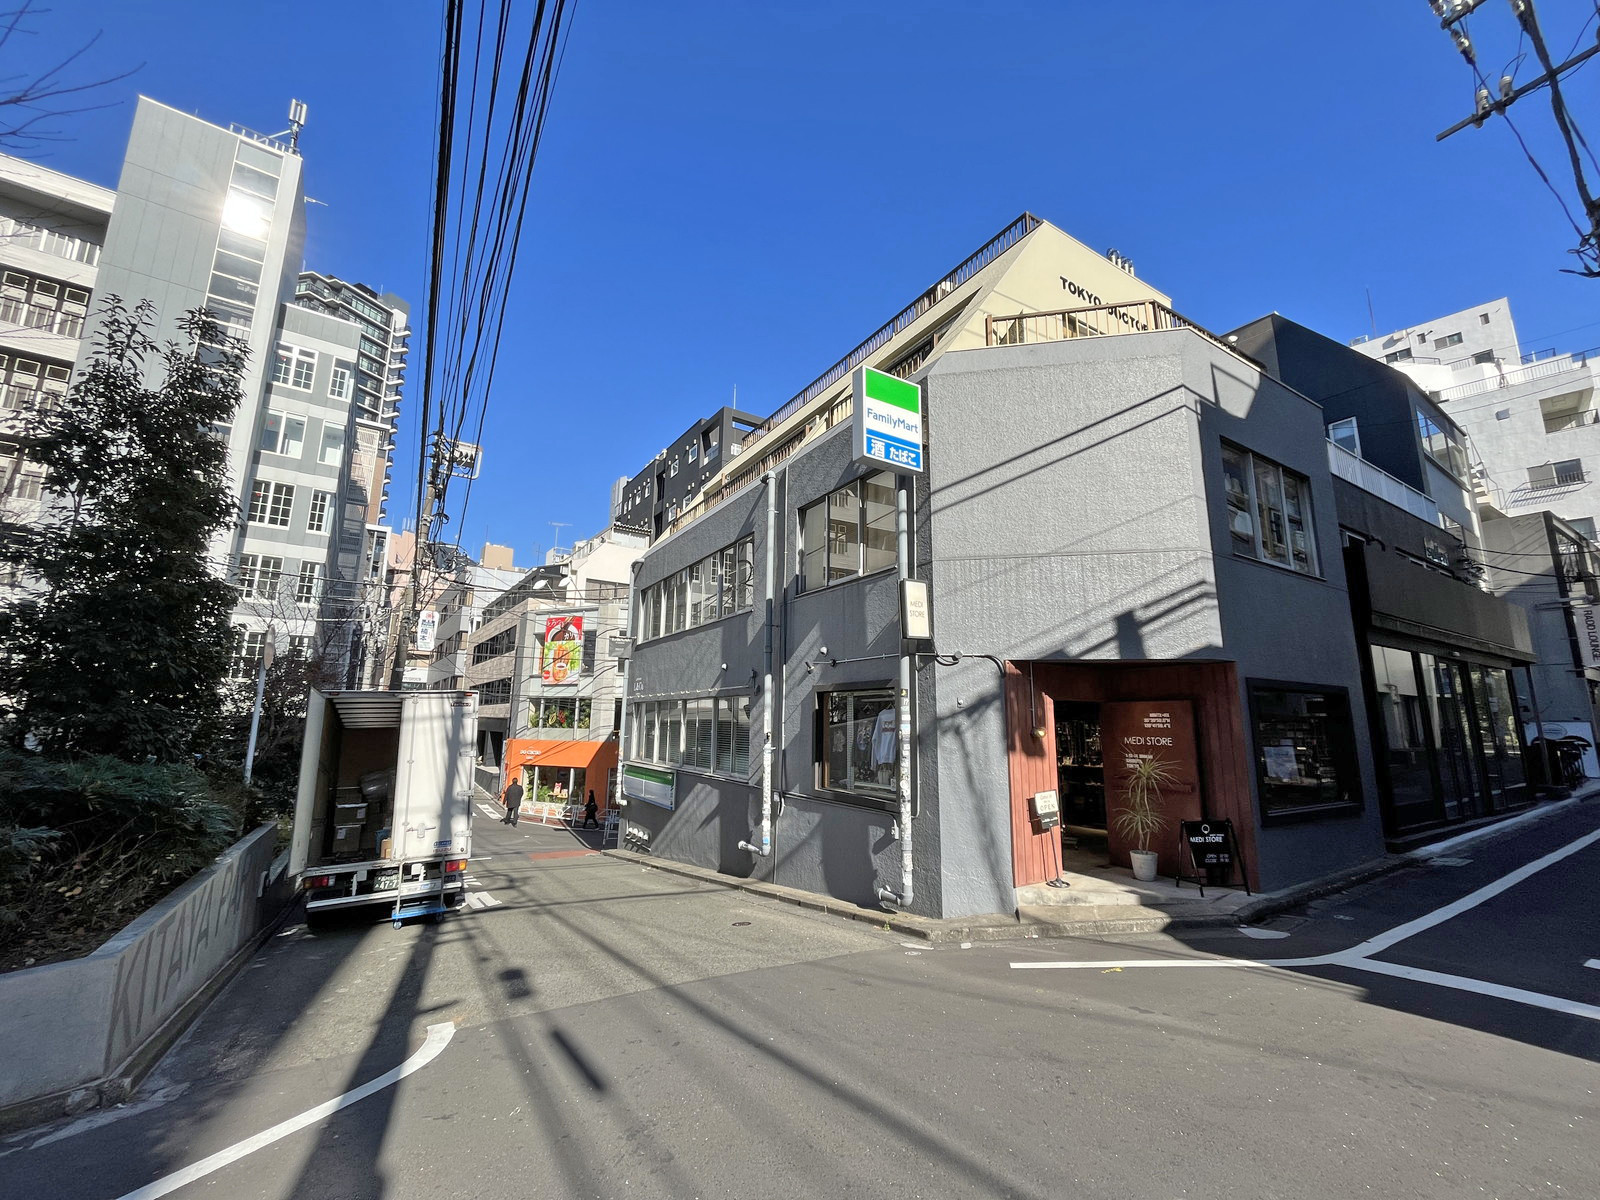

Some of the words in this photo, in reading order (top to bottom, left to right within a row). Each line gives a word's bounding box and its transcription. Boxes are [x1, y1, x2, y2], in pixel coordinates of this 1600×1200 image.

[1059, 275, 1102, 306] TOKYO
[866, 407, 919, 434] FamilyMart
[870, 438, 886, 459] 酒
[889, 446, 917, 466] たばこ
[909, 600, 923, 608] MEDI
[909, 610, 925, 618] STORE
[1587, 631, 1600, 662] LOUNGE
[1124, 736, 1145, 745] MEDI
[1146, 736, 1173, 747] STORE
